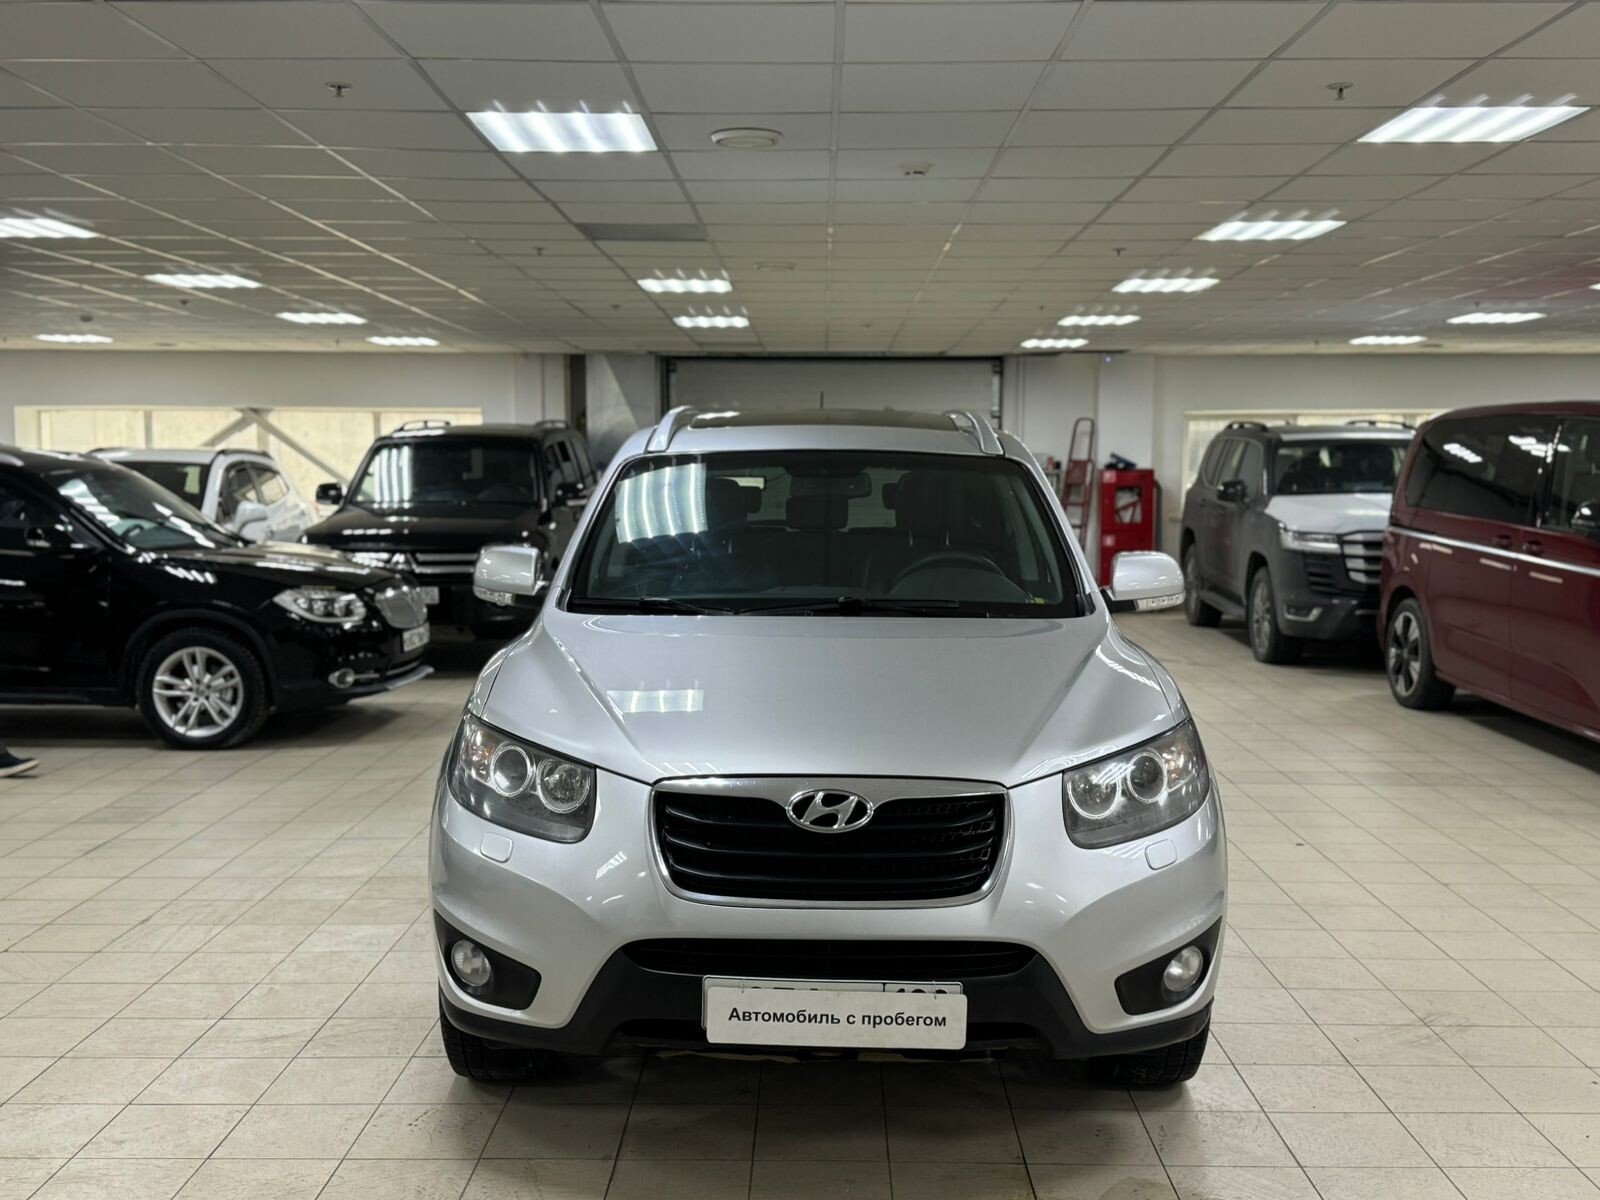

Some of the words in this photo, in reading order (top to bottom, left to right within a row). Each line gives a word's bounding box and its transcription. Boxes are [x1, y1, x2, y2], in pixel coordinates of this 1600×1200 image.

[728, 1007, 840, 1025] Автомобиль
[846, 1014, 856, 1024] с
[861, 1012, 947, 1028] пробегом
